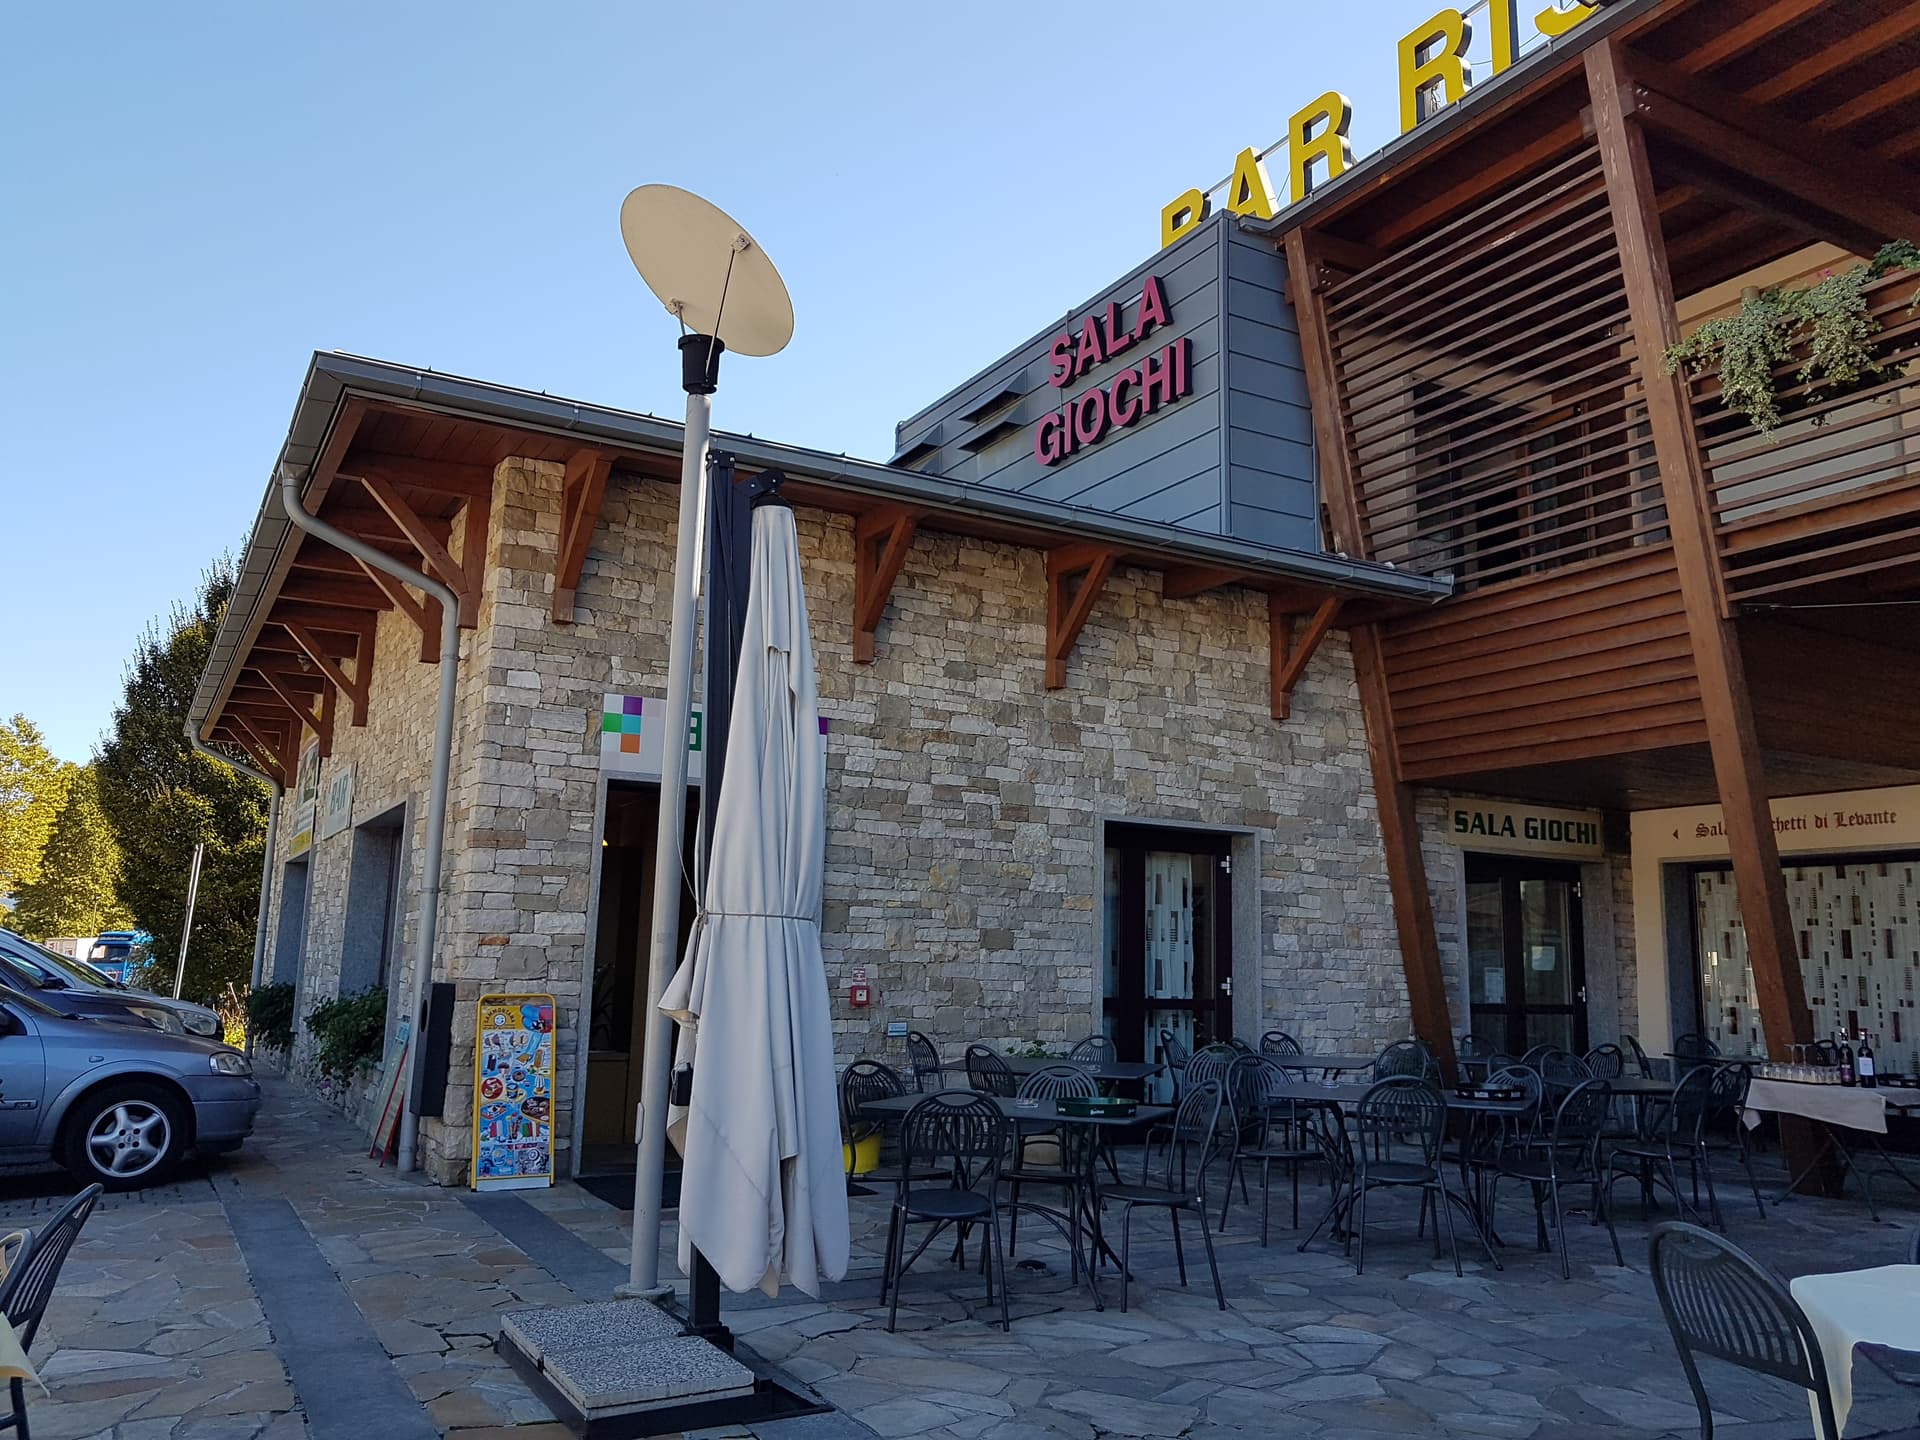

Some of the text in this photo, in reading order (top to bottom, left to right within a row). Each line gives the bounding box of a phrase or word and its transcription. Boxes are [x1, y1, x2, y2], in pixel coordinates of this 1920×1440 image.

[1161, 90, 1352, 248] BAR
[1049, 275, 1169, 388] SALA
[1034, 336, 1188, 466] GIOCHI
[1454, 810, 1598, 845] SALA GIOCHI
[1814, 814, 1828, 829] di
[1833, 809, 1898, 829] Levante
